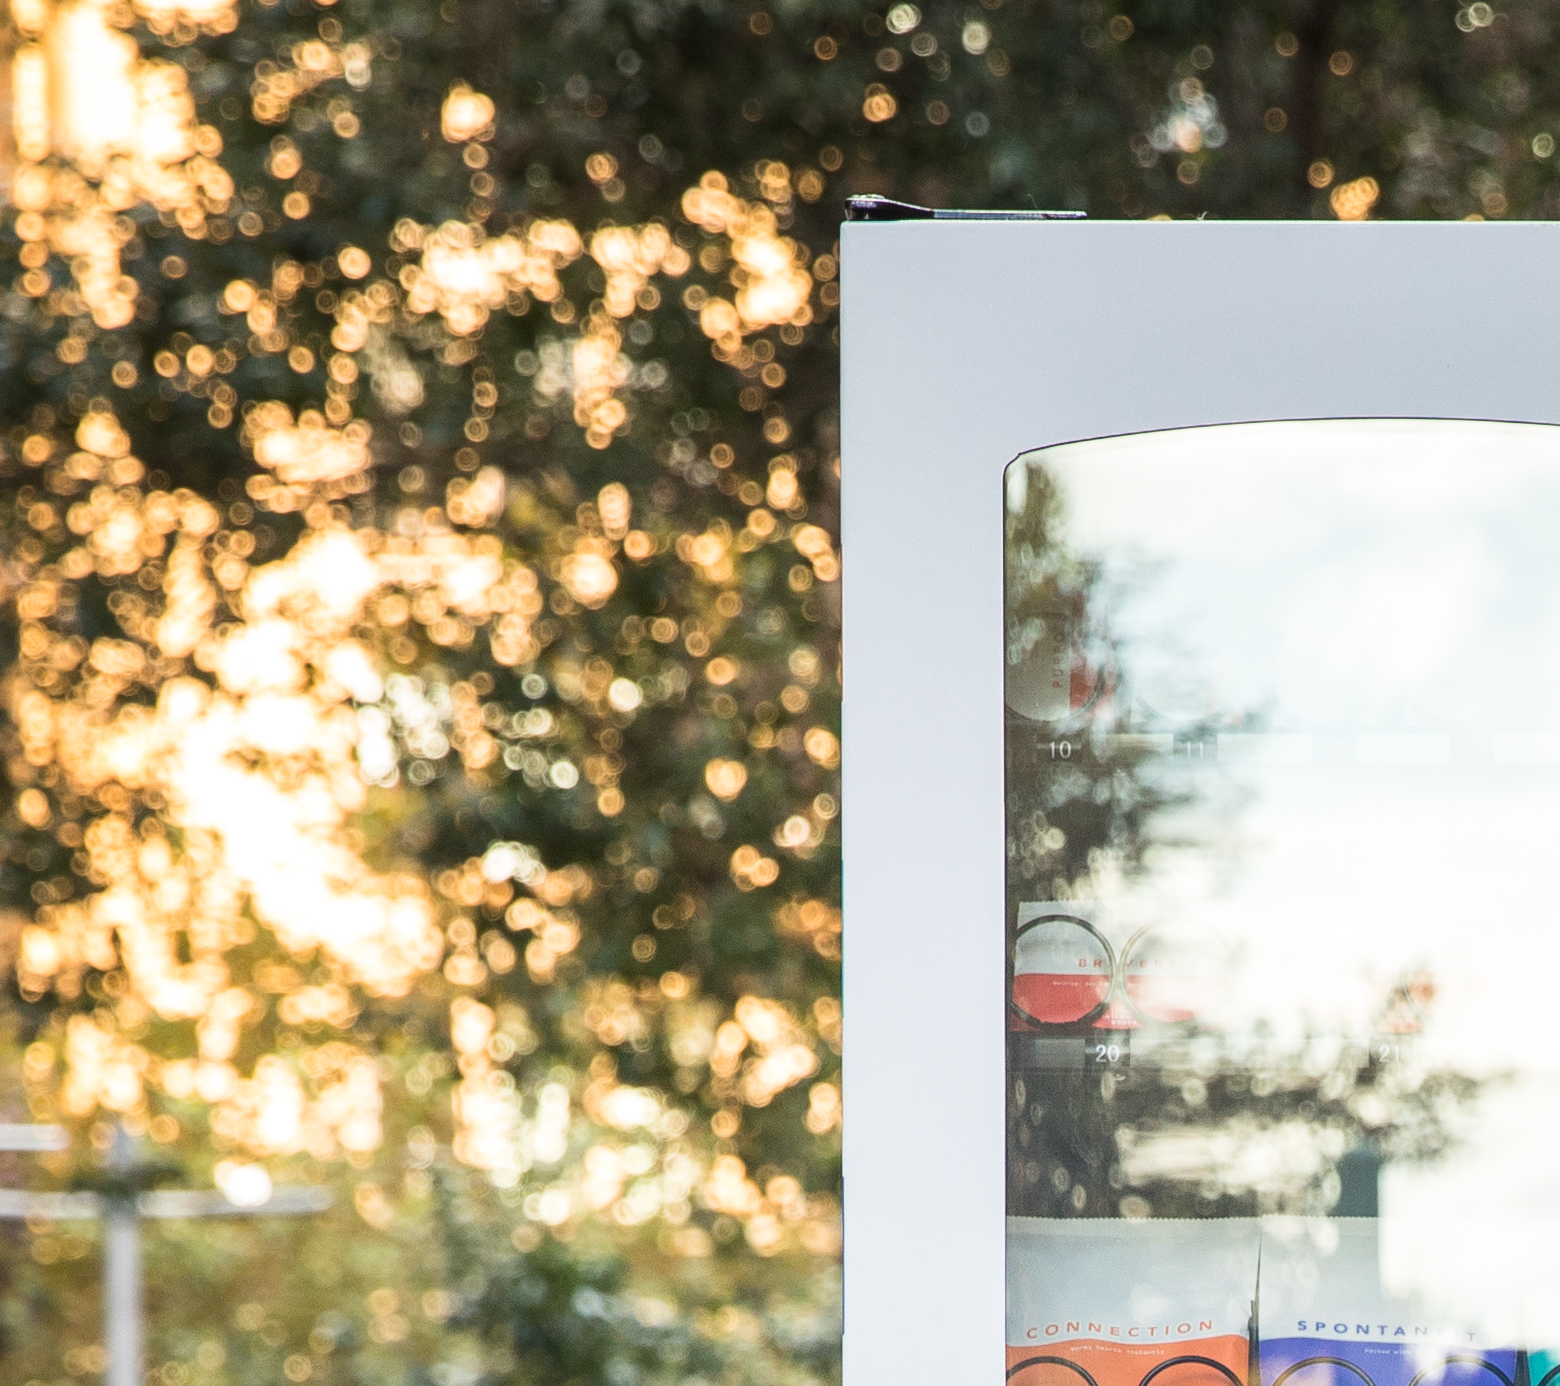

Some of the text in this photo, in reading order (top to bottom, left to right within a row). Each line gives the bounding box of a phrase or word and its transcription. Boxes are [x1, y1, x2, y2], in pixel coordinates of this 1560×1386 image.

[1049, 741, 1071, 759] 10
[1078, 958, 1177, 968] BRVERY
[1095, 1044, 1400, 1063] 20 21
[1026, 1320, 1214, 1340] CONNECTION
